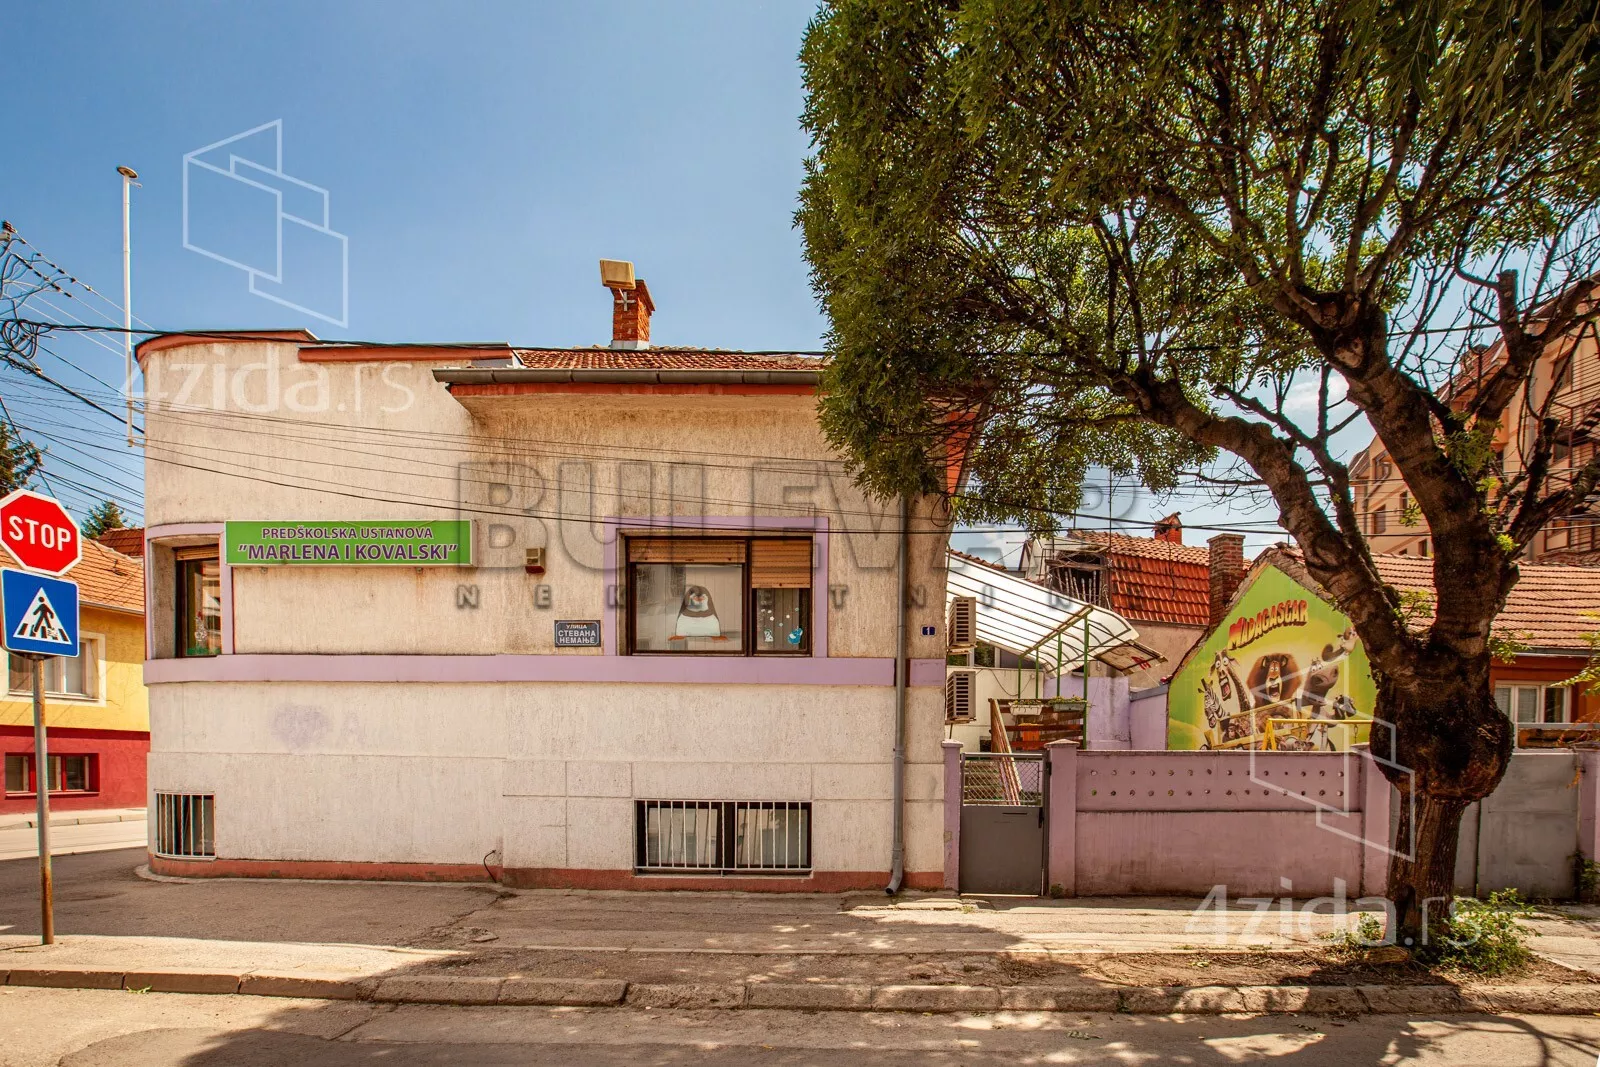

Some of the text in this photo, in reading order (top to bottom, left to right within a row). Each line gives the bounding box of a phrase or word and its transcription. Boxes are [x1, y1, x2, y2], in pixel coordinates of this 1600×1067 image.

[8, 515, 71, 551] STOP
[262, 525, 433, 539] PREDŠKOLSKA USTANOVA
[238, 544, 458, 560] "MARLENA I KOVALSKI"
[1227, 599, 1308, 650] MADAGASCAR
